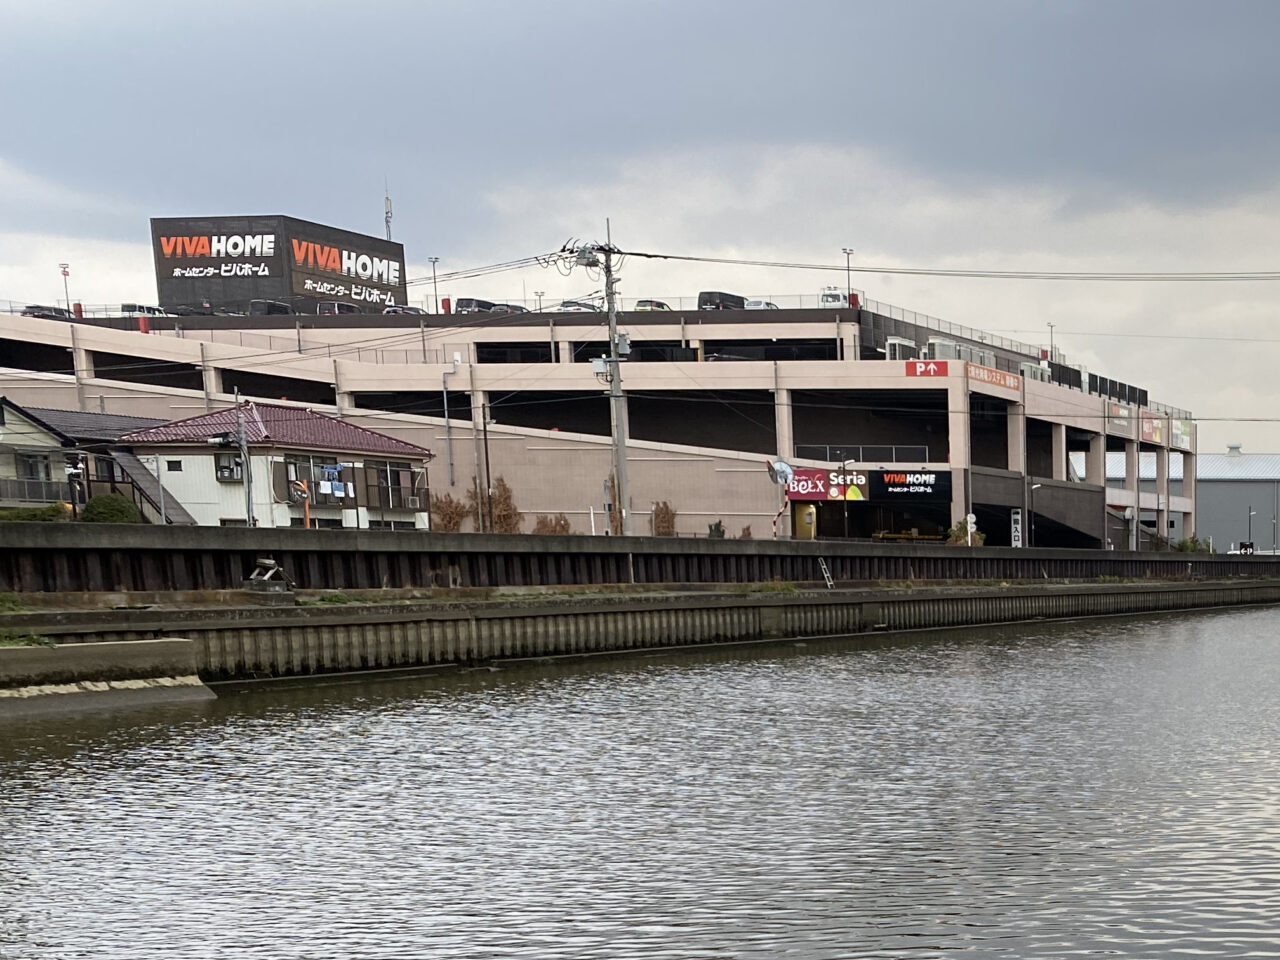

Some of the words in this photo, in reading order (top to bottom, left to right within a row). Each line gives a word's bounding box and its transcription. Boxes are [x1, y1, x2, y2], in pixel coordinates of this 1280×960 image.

[160, 234, 275, 258] VIVAHOME
[172, 267, 219, 277] ホームセンター
[220, 262, 269, 276] ビバホーム
[292, 238, 400, 286] VIVAHOME
[304, 279, 350, 296] ホームセンター
[351, 284, 395, 307] ビバホーム
[916, 362, 926, 376] P
[829, 471, 866, 485] Seria
[883, 473, 936, 485] VIVAHOME
